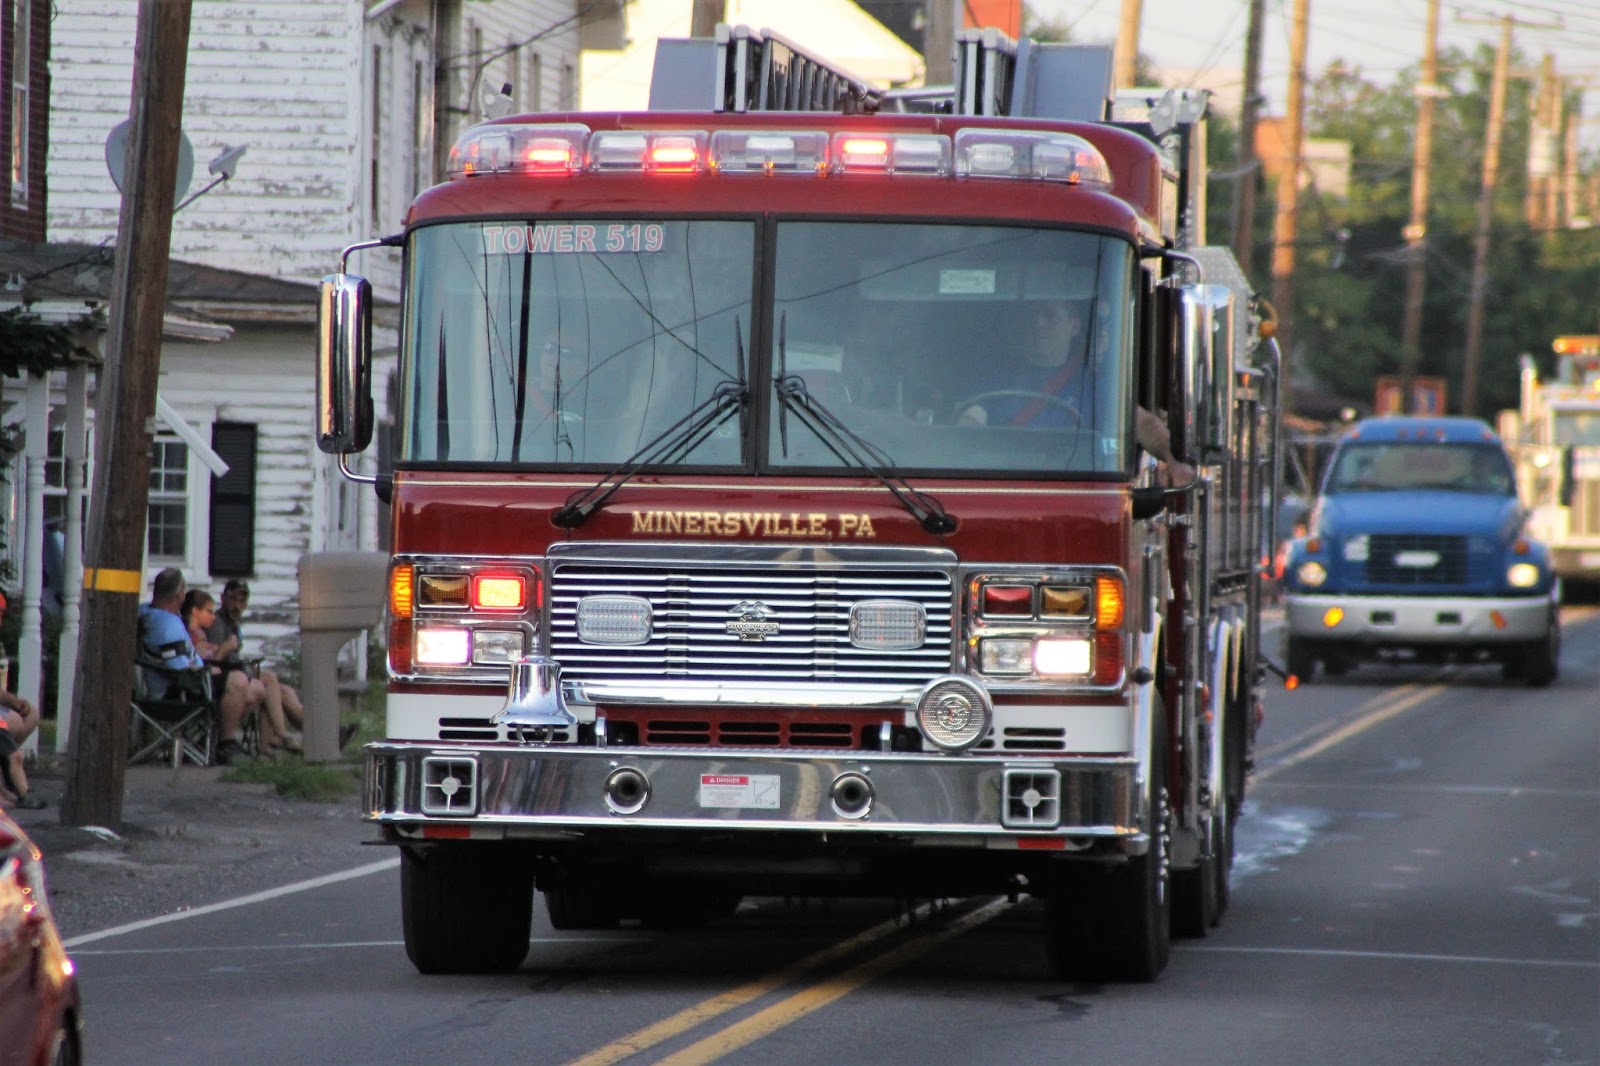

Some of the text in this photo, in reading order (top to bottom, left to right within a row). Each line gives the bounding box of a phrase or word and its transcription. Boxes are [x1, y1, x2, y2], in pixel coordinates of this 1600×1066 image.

[484, 224, 664, 253] TOWER 519
[632, 510, 876, 538] MINERSVILLE, PA
